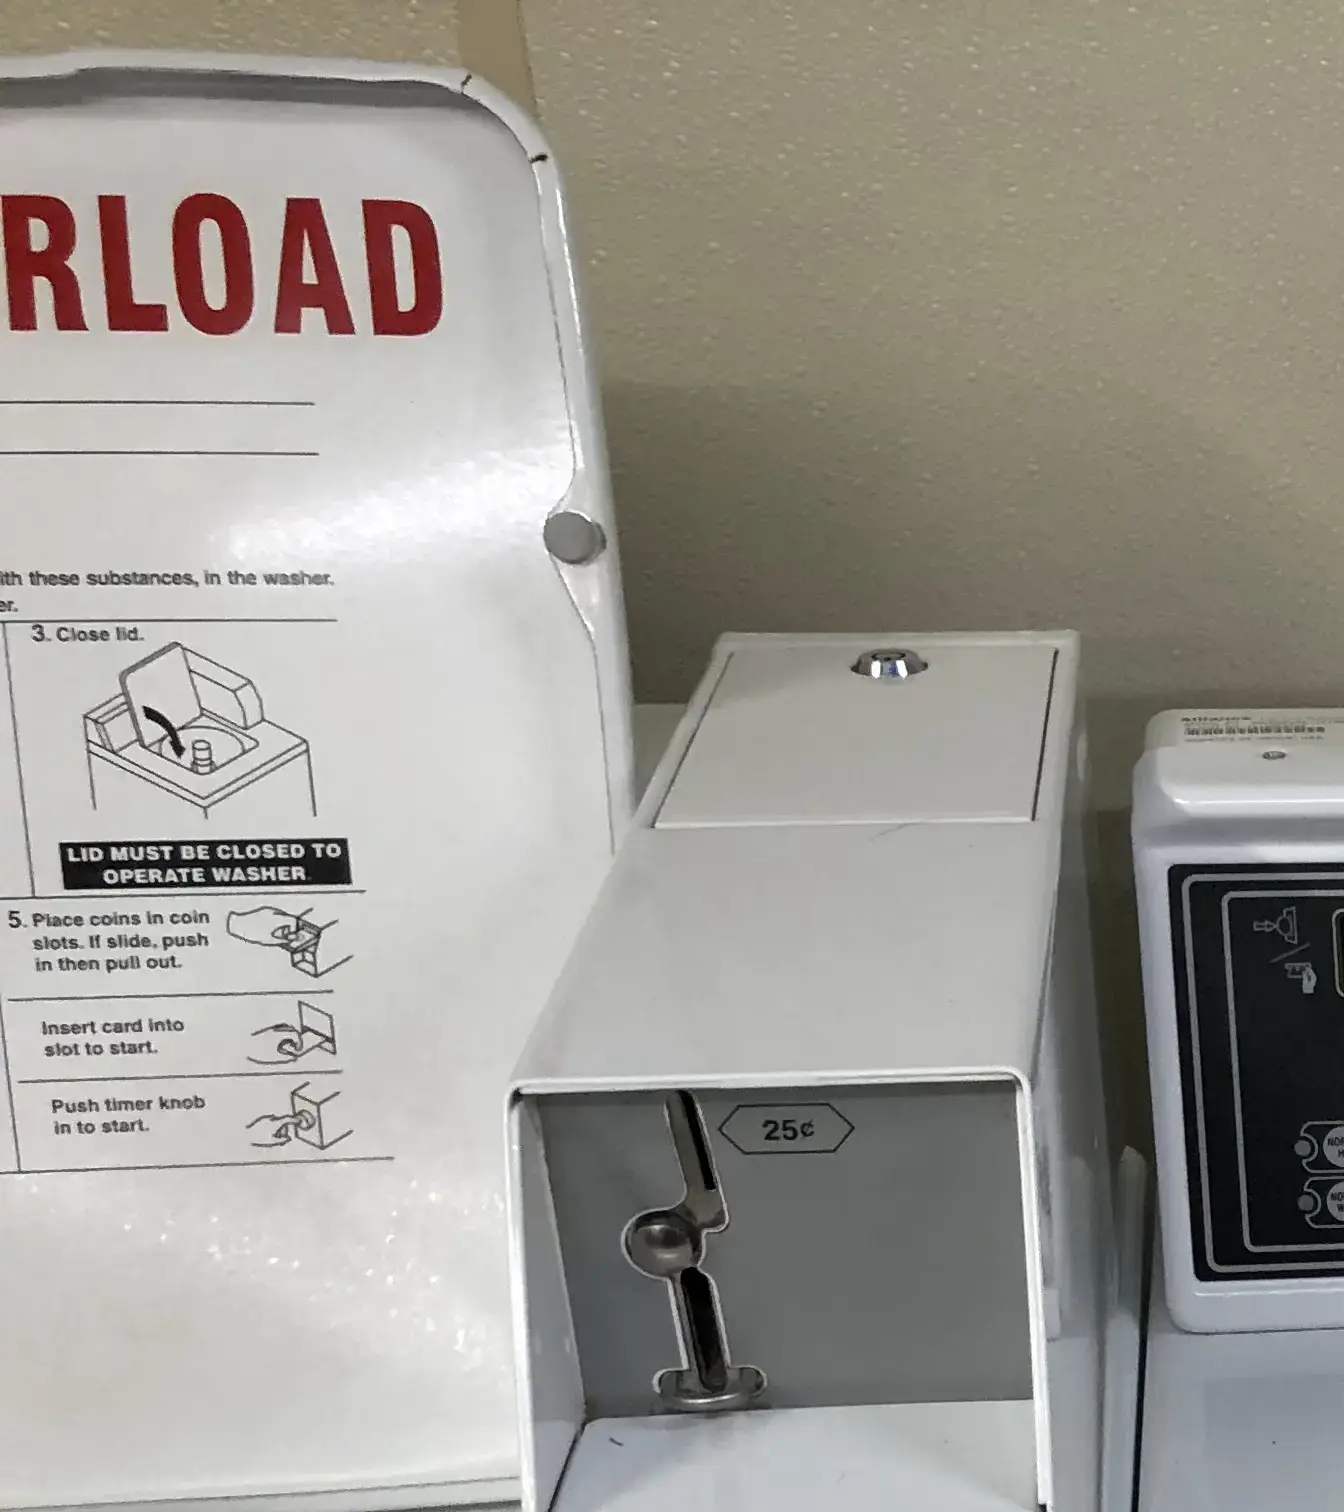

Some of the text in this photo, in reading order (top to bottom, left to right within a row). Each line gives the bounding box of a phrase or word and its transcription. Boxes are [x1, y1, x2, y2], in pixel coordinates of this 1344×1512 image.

[0, 193, 443, 336] RLOAD
[28, 570, 80, 586] these
[86, 570, 200, 588] substances,
[204, 570, 222, 586] in
[227, 570, 257, 586] the
[263, 570, 335, 586] washer.
[32, 624, 145, 642] 3. Close lid.
[67, 843, 341, 863] LID MUST BE CLOSED TO
[102, 866, 206, 885] OPERATE
[8, 910, 211, 928] 5. Place coins in coin
[32, 935, 84, 951] slots.
[88, 934, 102, 949] If
[162, 932, 210, 951] push
[35, 955, 183, 973] in then pull out.
[42, 1018, 185, 1035] Insert card into
[44, 1040, 158, 1057] slot to start.
[51, 1095, 206, 1114] Push timer knob
[54, 1119, 150, 1135] in to start.
[761, 1119, 815, 1141] 25¢
